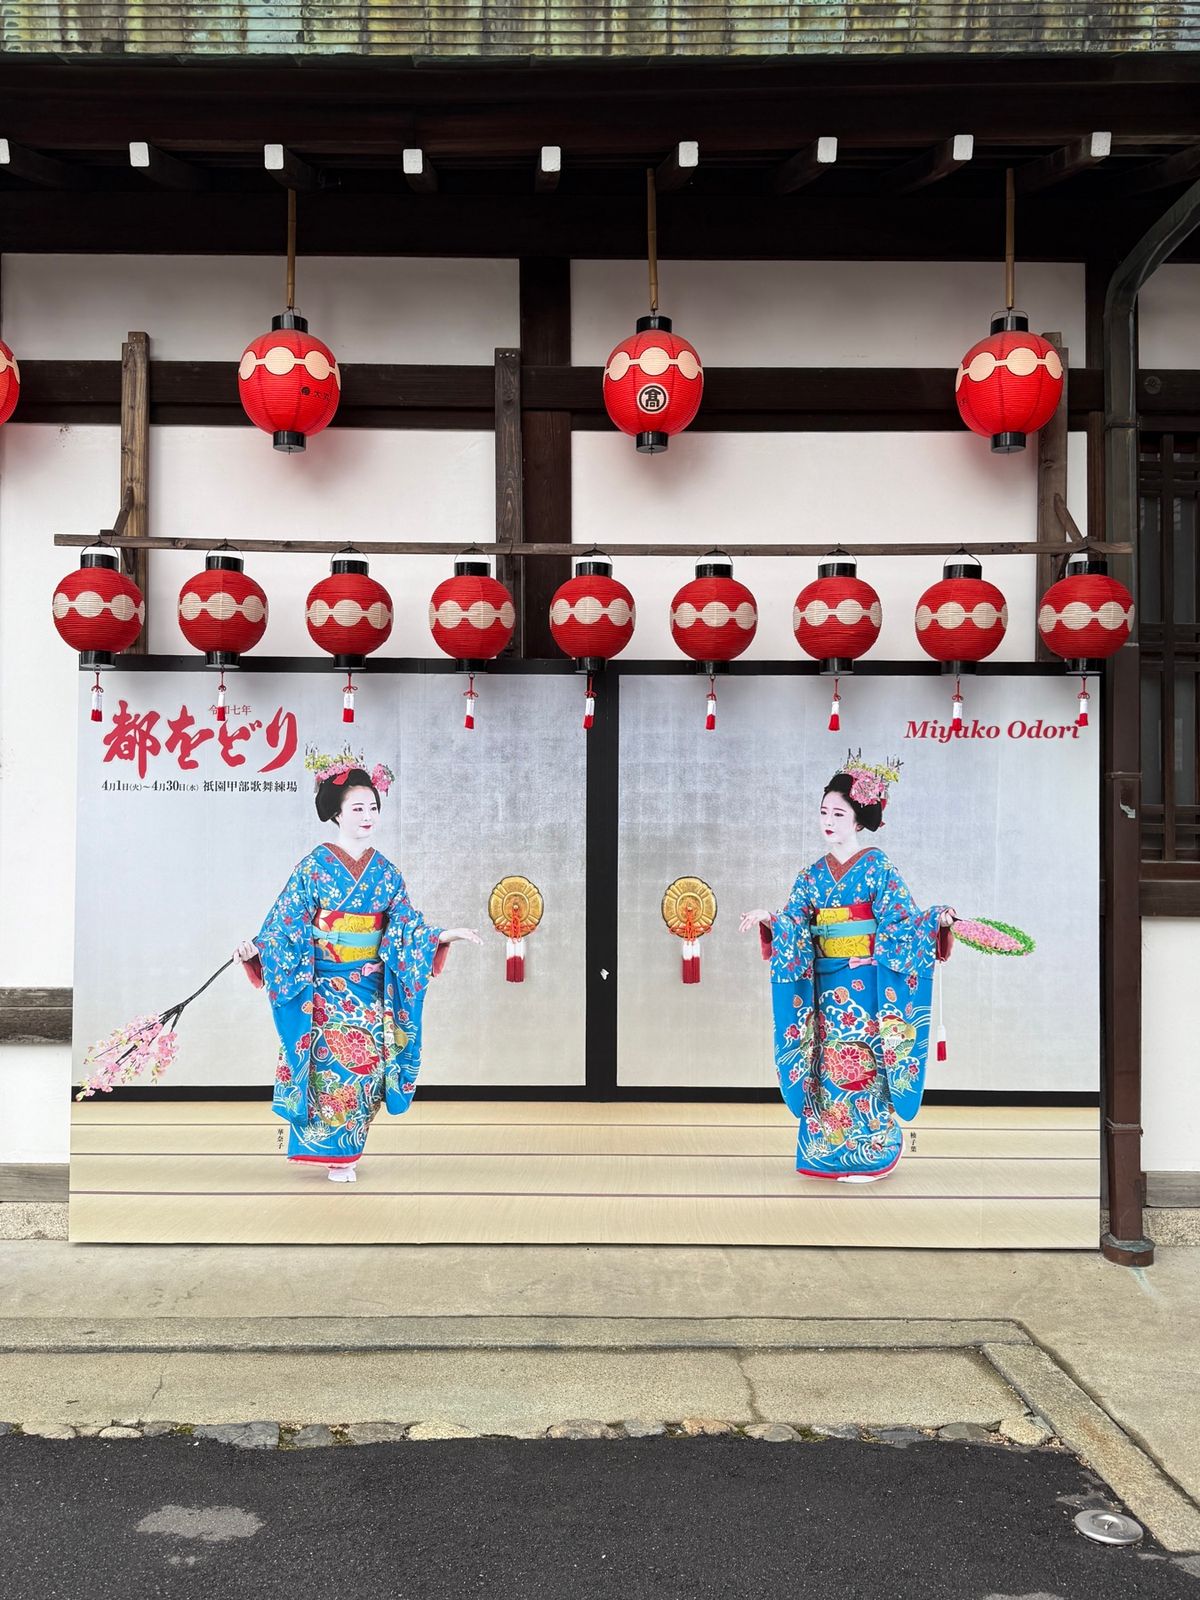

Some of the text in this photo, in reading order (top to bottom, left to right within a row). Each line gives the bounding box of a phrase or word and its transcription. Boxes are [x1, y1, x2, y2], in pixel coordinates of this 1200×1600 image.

[103, 700, 298, 779] 都をどり
[904, 719, 1080, 743] Miyako Odori
[203, 780, 298, 792] 祇園甲部歌舞練場
